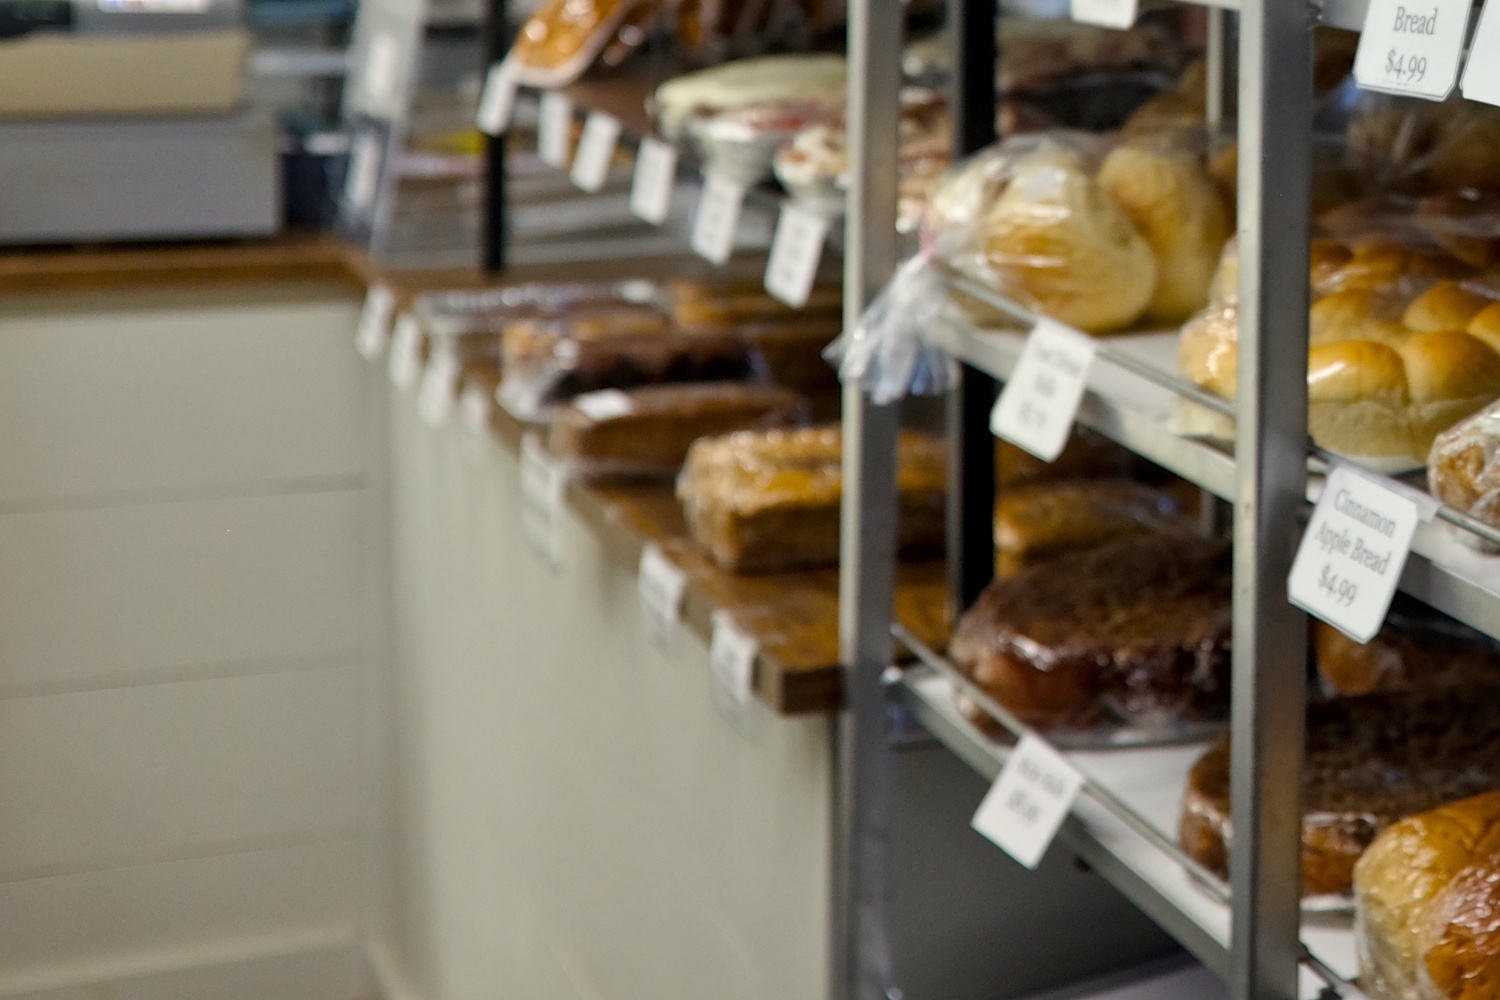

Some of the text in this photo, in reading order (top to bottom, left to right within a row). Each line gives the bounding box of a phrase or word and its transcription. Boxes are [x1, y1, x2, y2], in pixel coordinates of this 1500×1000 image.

[1393, 6, 1438, 35] Bread
[1384, 46, 1427, 82] $4.99
[1333, 489, 1398, 538] Cinnamon
[1314, 521, 1392, 576] Apple Bread
[1318, 563, 1357, 608] $4.99
